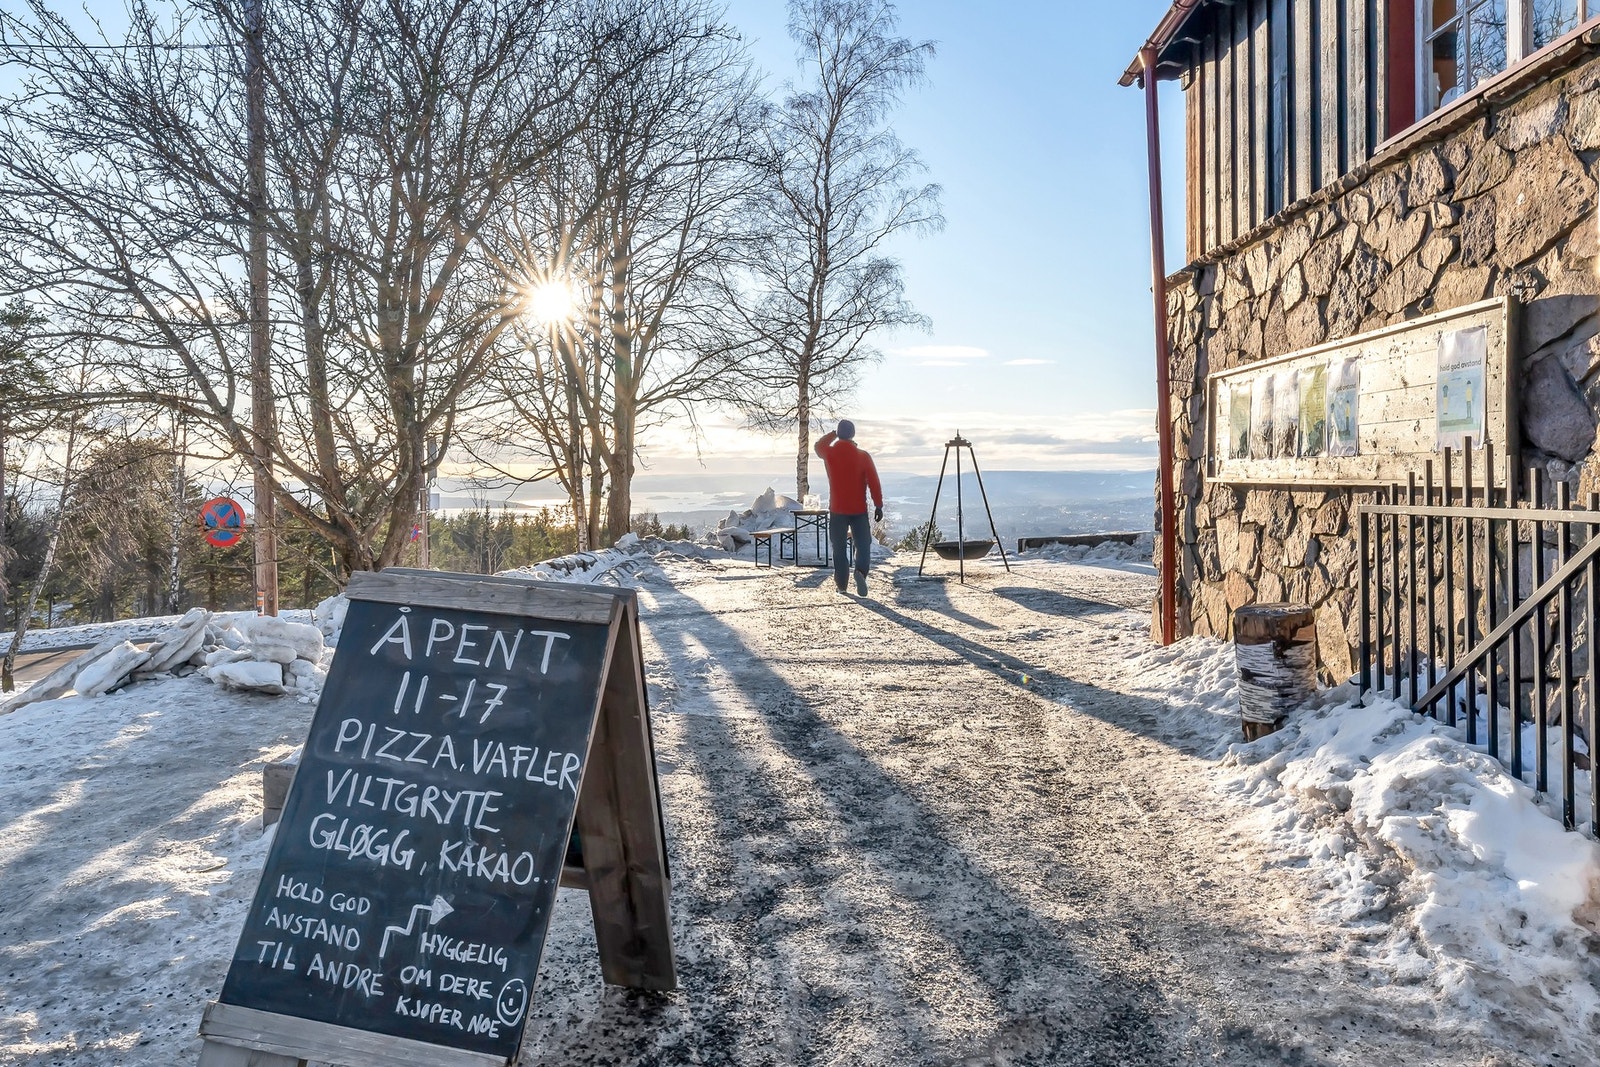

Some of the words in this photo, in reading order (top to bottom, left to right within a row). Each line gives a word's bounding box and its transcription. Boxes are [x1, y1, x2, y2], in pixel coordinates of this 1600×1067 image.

[1450, 361, 1461, 372] god
[1461, 357, 1482, 369] avstand
[371, 607, 570, 674] ÅPENT
[473, 739, 580, 793] VAFLER
[326, 768, 503, 832] VILTGRYTE
[276, 874, 324, 904] HOLD
[330, 893, 371, 915] GOD
[265, 907, 360, 951] AVSTAND
[257, 941, 296, 970] TIL
[306, 953, 384, 997] ANDRE
[420, 932, 507, 972] HYGGELIG
[400, 966, 432, 987] OM
[439, 974, 493, 1000] DERE
